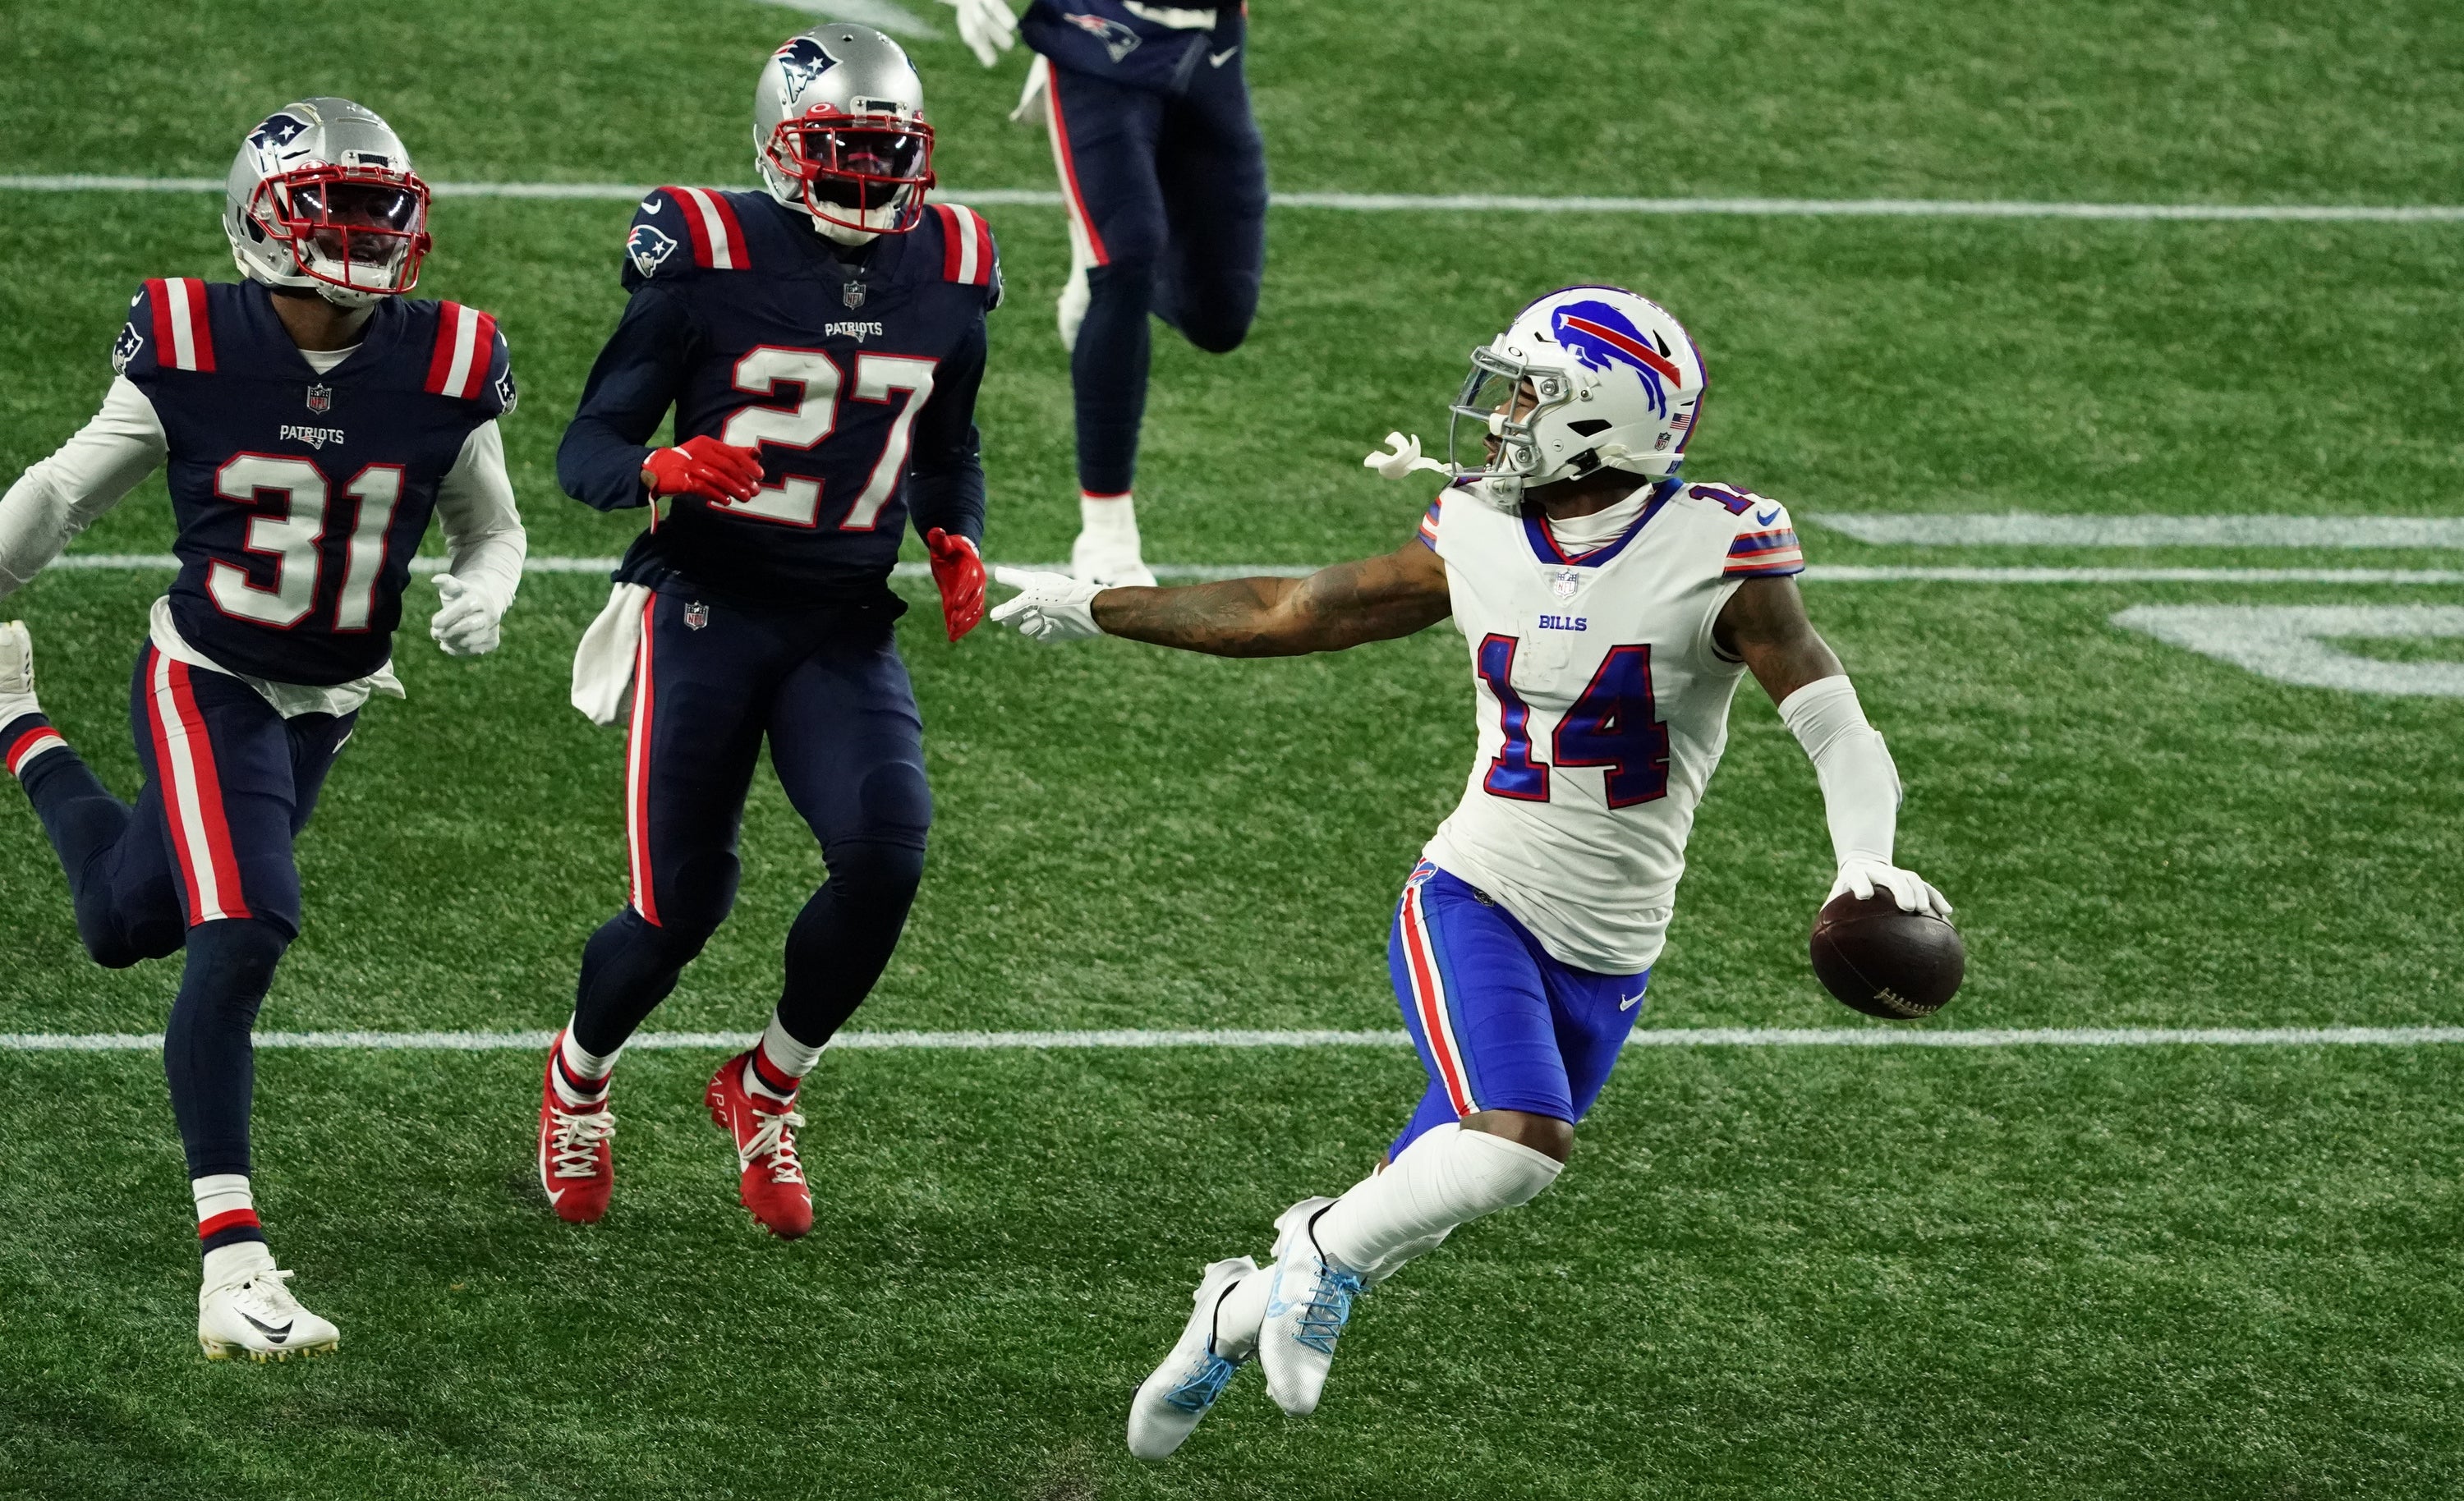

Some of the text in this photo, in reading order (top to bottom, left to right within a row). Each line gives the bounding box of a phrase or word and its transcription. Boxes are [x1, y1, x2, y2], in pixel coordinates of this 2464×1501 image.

[825, 322, 883, 337] PATRIOTS
[279, 425, 344, 444] PATRIOTS
[706, 344, 941, 531] 27
[1688, 484, 1756, 516] 1
[205, 450, 405, 633] 31
[1538, 615, 1587, 631] BILLS
[1478, 632, 1670, 810] 14
